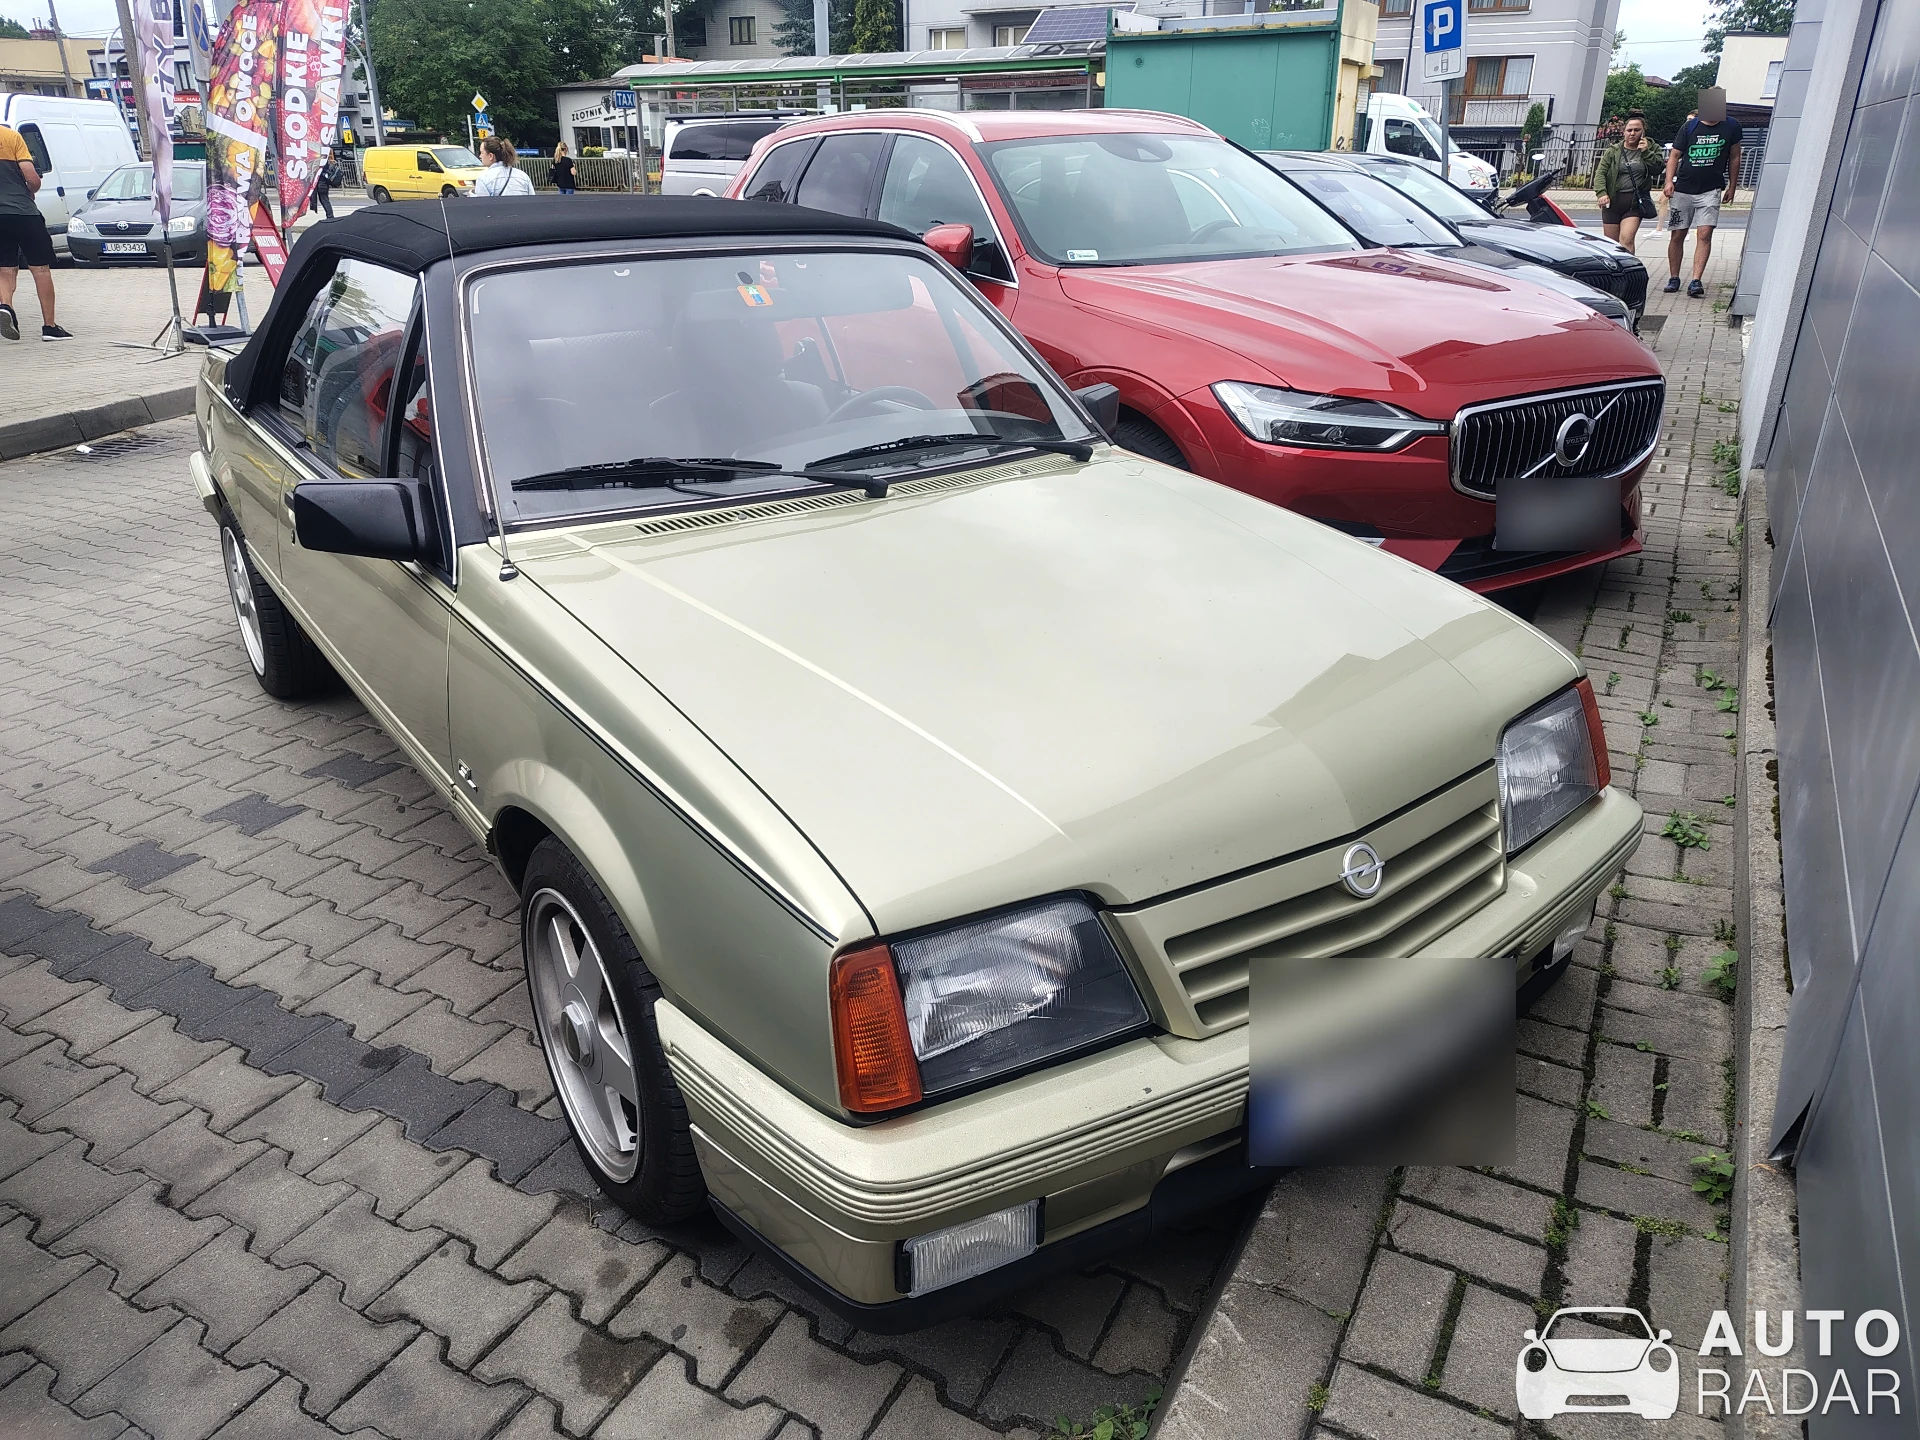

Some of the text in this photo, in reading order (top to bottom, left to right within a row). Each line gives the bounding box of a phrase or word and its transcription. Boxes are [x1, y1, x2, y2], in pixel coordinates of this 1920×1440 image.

[1433, 6, 1453, 47] P
[235, 14, 257, 122] OWOCE
[284, 31, 308, 180] SŁODKIE
[617, 93, 635, 106] TAXI
[571, 107, 602, 122] ZŁOTNIK
[1696, 137, 1719, 145] JESTEM
[107, 243, 121, 252] LUB
[1565, 436, 1589, 445] VOLVO
